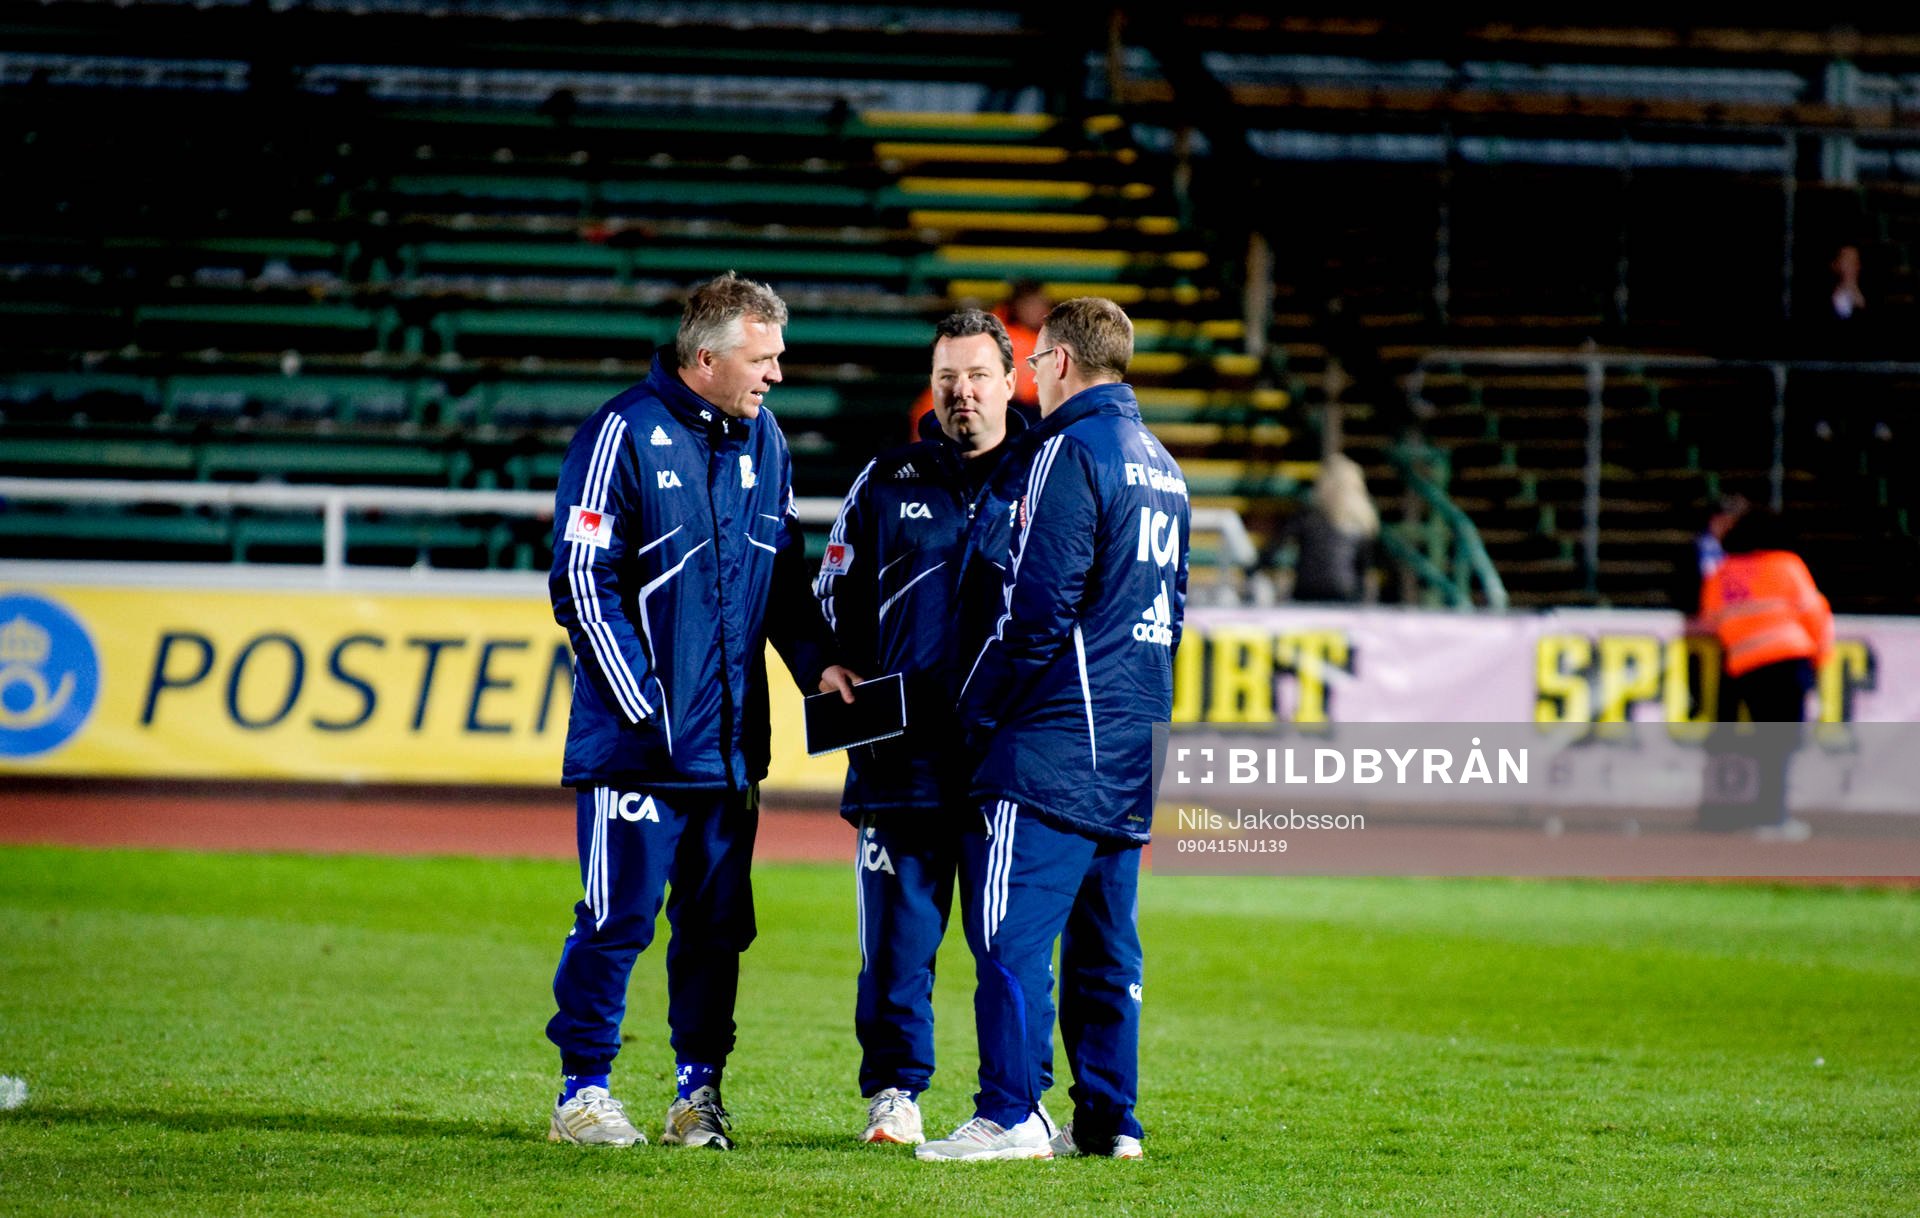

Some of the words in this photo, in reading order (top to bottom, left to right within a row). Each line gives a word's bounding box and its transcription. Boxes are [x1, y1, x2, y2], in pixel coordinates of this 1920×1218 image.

[656, 470, 682, 489] ICA
[900, 502, 933, 518] ICA
[608, 790, 660, 823] ICA
